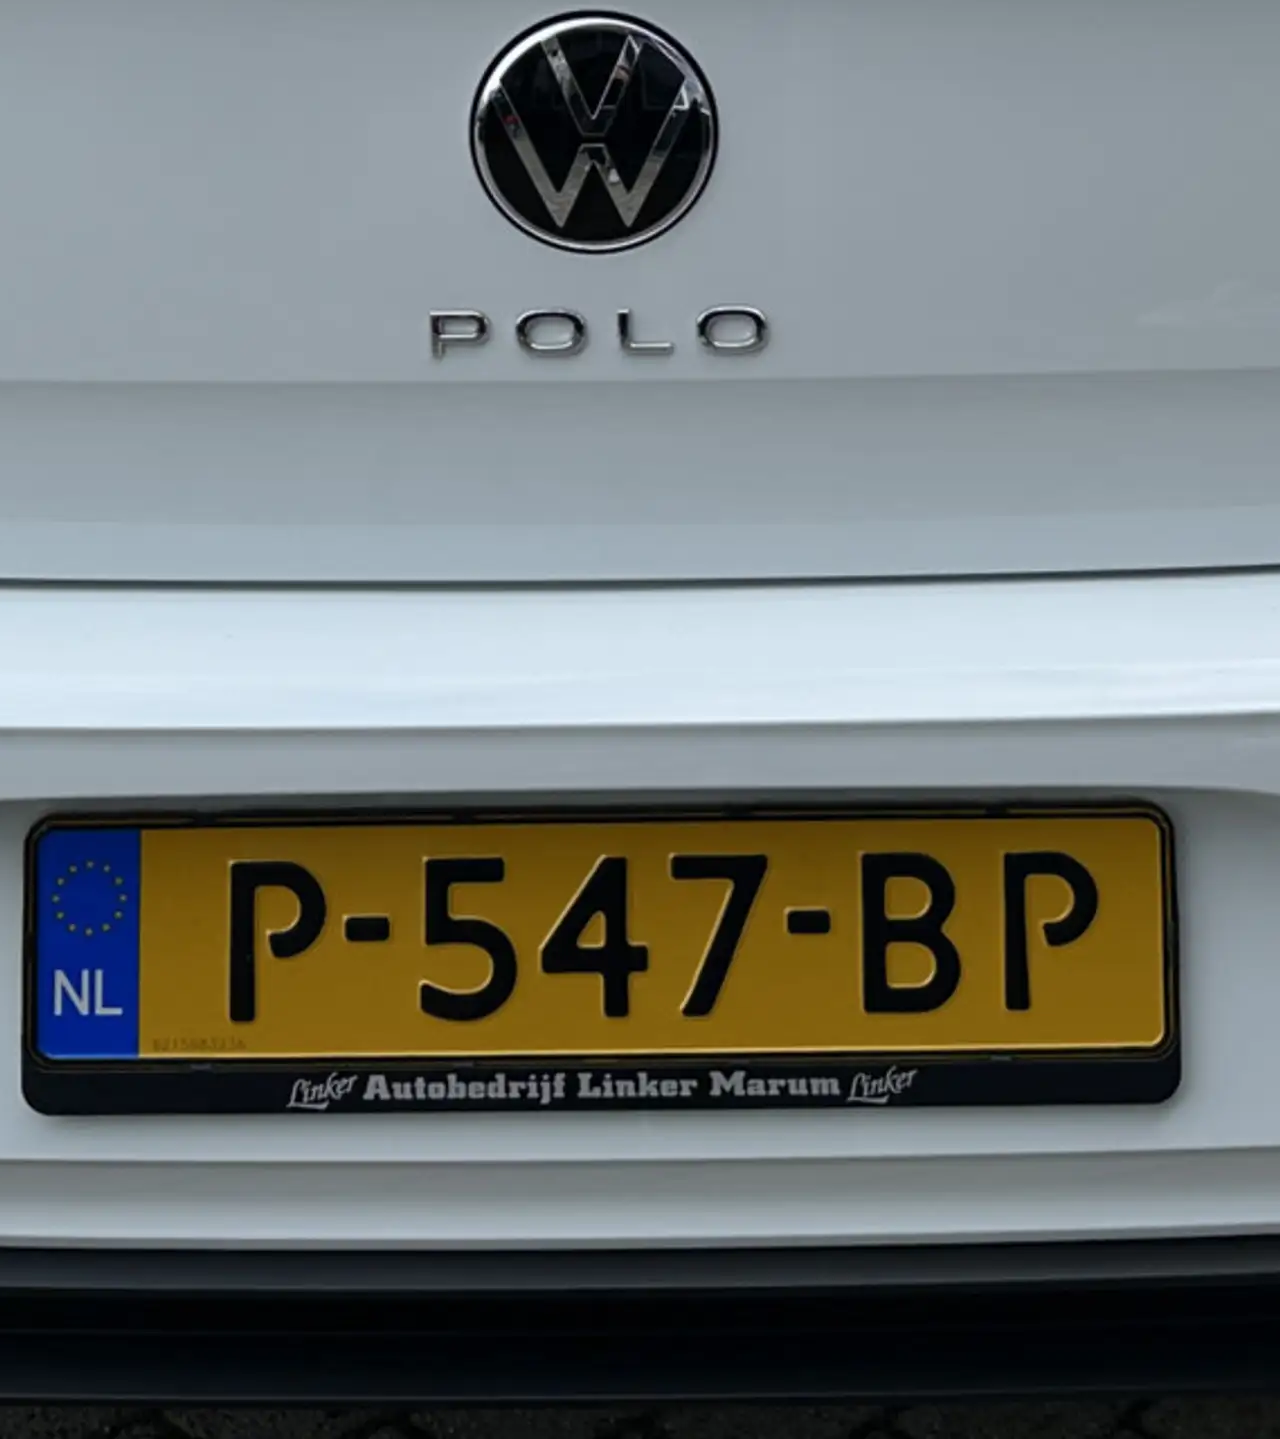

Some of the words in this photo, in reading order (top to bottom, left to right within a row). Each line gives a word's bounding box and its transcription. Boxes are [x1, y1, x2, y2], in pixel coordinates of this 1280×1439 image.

[429, 305, 768, 360] POLO
[227, 850, 1100, 1023] P-547-BP
[53, 968, 124, 1017] NL
[286, 1071, 359, 1110] Linker
[363, 1073, 567, 1104] Autobedrijf
[577, 1072, 698, 1099] Linker
[709, 1070, 841, 1097] Marum
[846, 1065, 919, 1105] Linker
